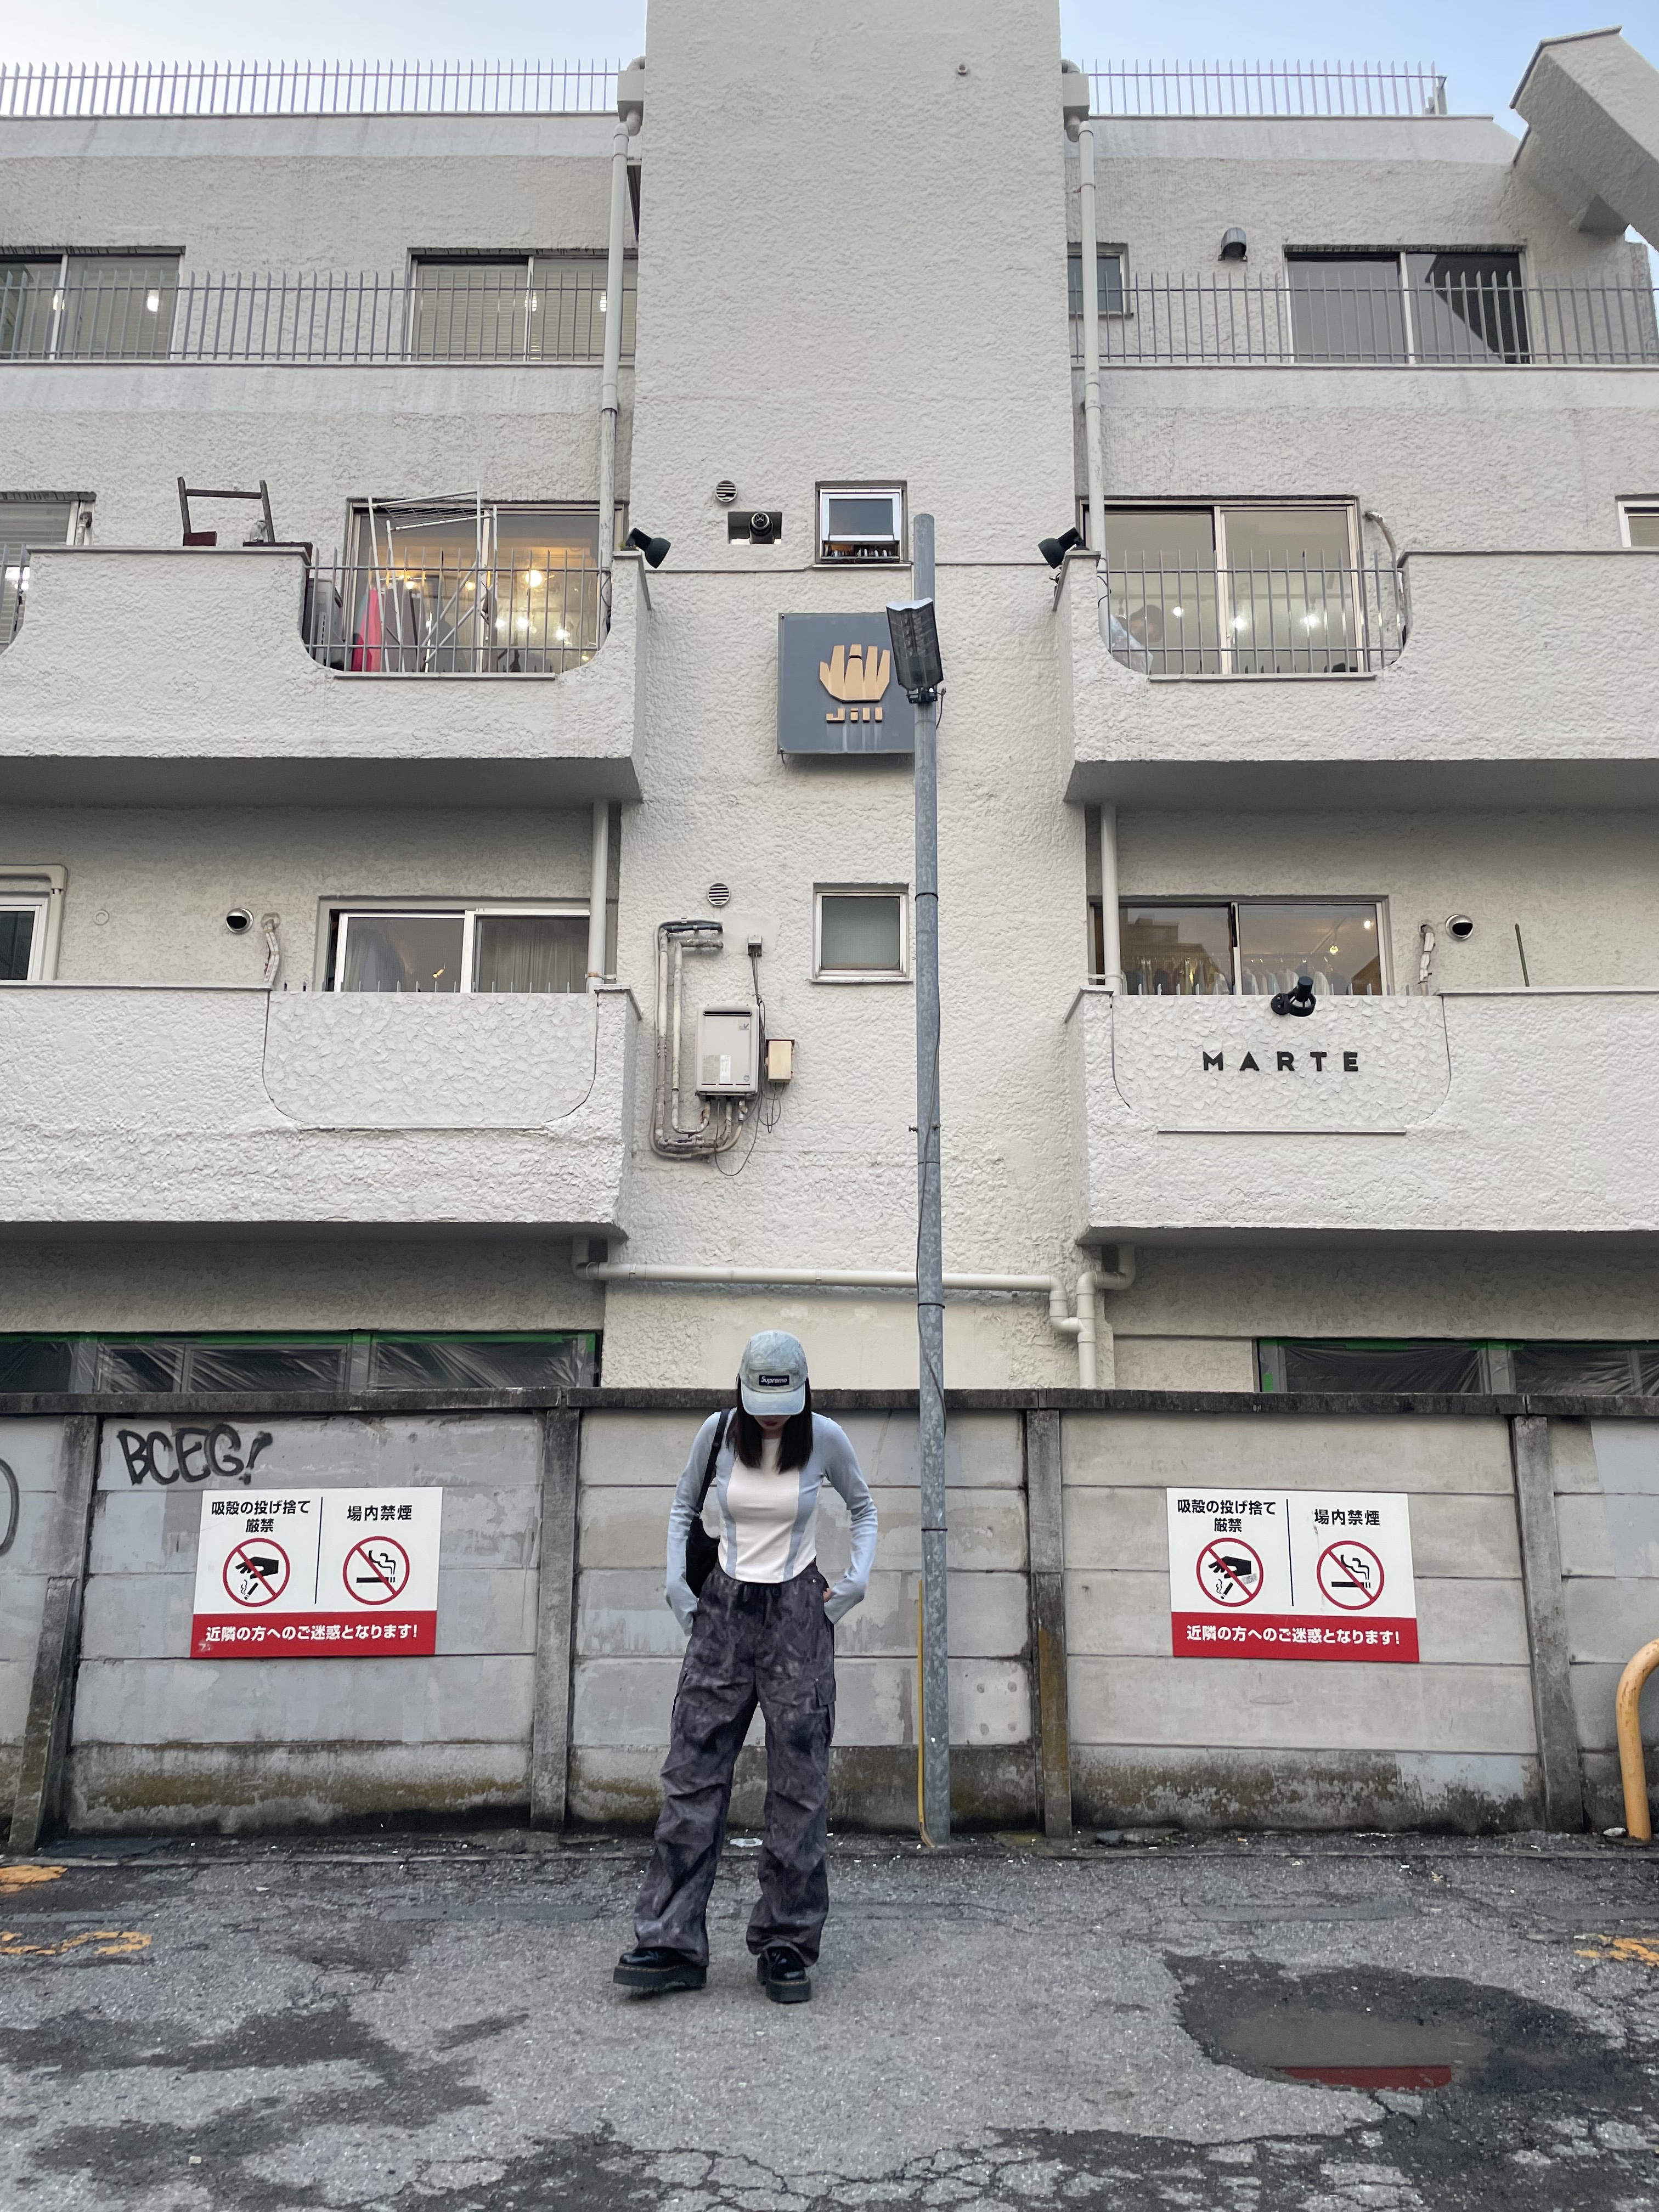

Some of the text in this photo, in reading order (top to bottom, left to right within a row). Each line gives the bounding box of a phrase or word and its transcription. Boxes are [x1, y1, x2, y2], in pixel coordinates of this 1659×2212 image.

[1203, 1051, 1359, 1072] MARTE
[760, 1375, 787, 1385] Supreme
[211, 1499, 311, 1515] 吸殻の投げ捨て
[347, 1504, 413, 1521] 場内禁煙
[1177, 1499, 1276, 1515] 吸殻の投げ捨て
[245, 1518, 274, 1533] 厳禁
[1214, 1517, 1242, 1533] 厳禁
[1314, 1509, 1380, 1526] 場内禁煙
[205, 1623, 417, 1642] 近隣の方へのご迷惑となります!
[1187, 1624, 1400, 1645] 近隣の方へのご迷惑となります!
